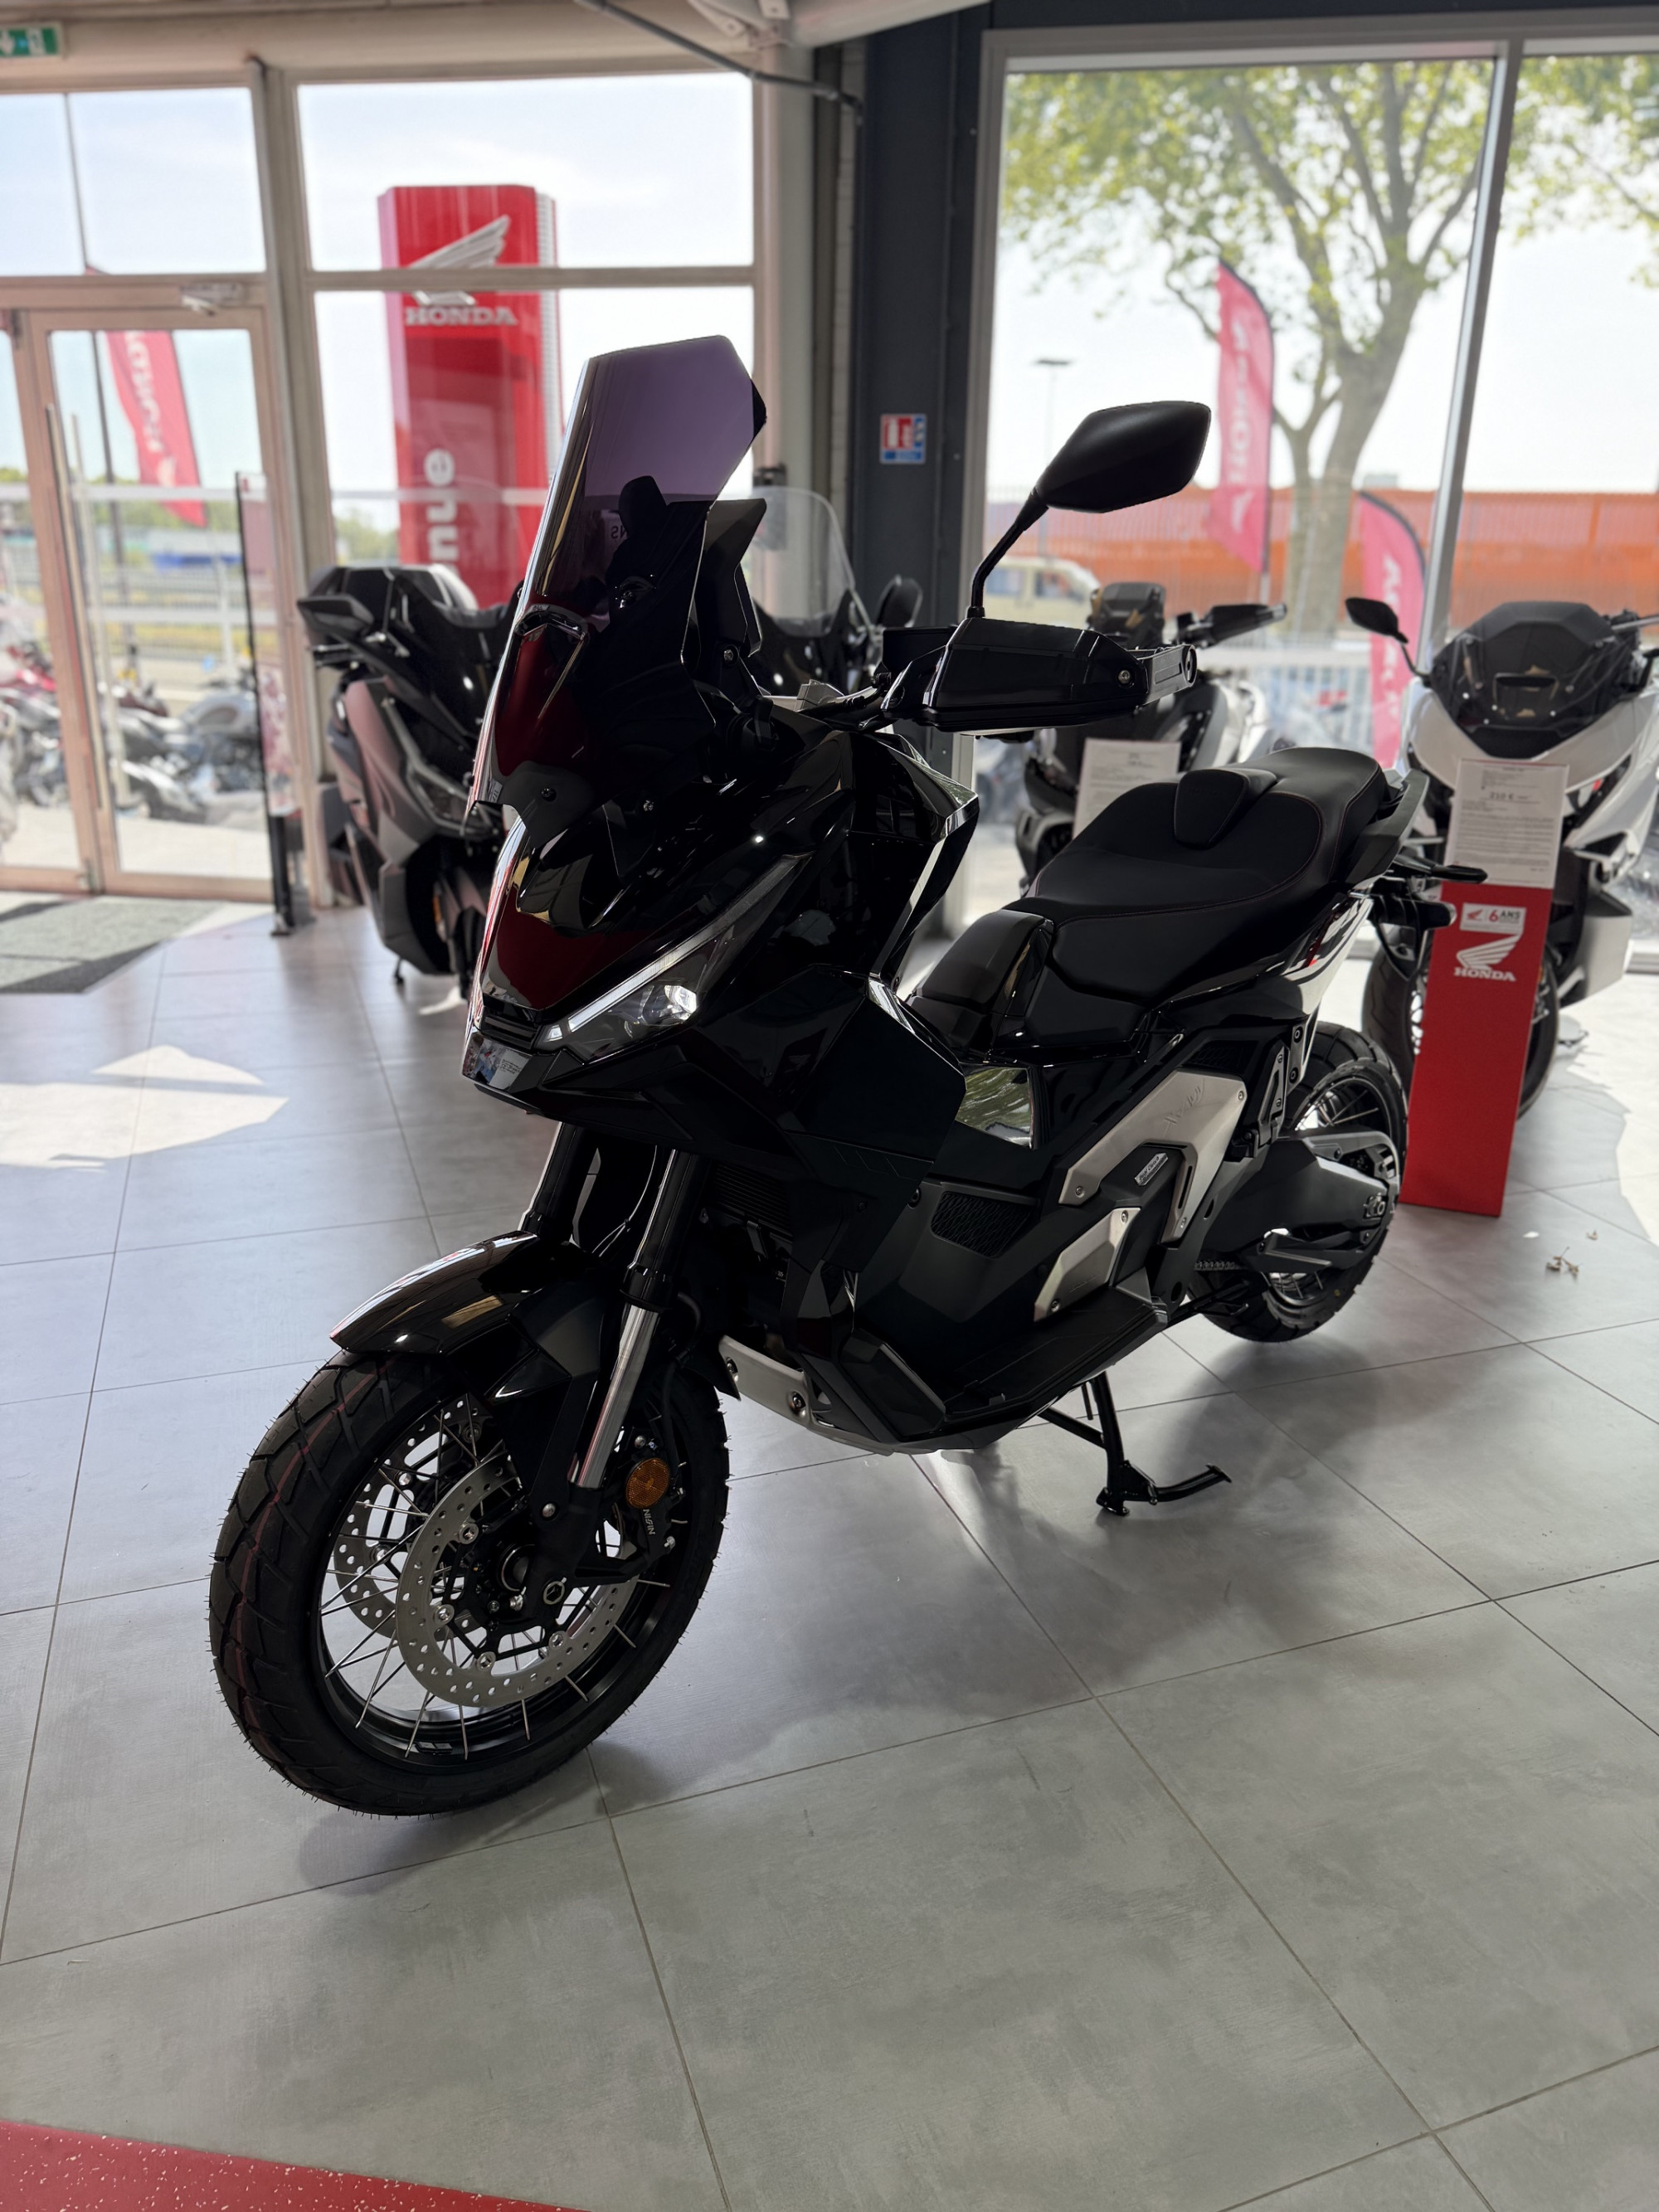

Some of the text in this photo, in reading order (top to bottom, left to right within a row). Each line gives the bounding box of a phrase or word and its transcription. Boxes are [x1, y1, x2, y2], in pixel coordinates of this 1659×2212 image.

[405, 306, 518, 326] HONDA
[1489, 910, 1520, 922] 6 ANS
[1454, 967, 1516, 982] HONDA
